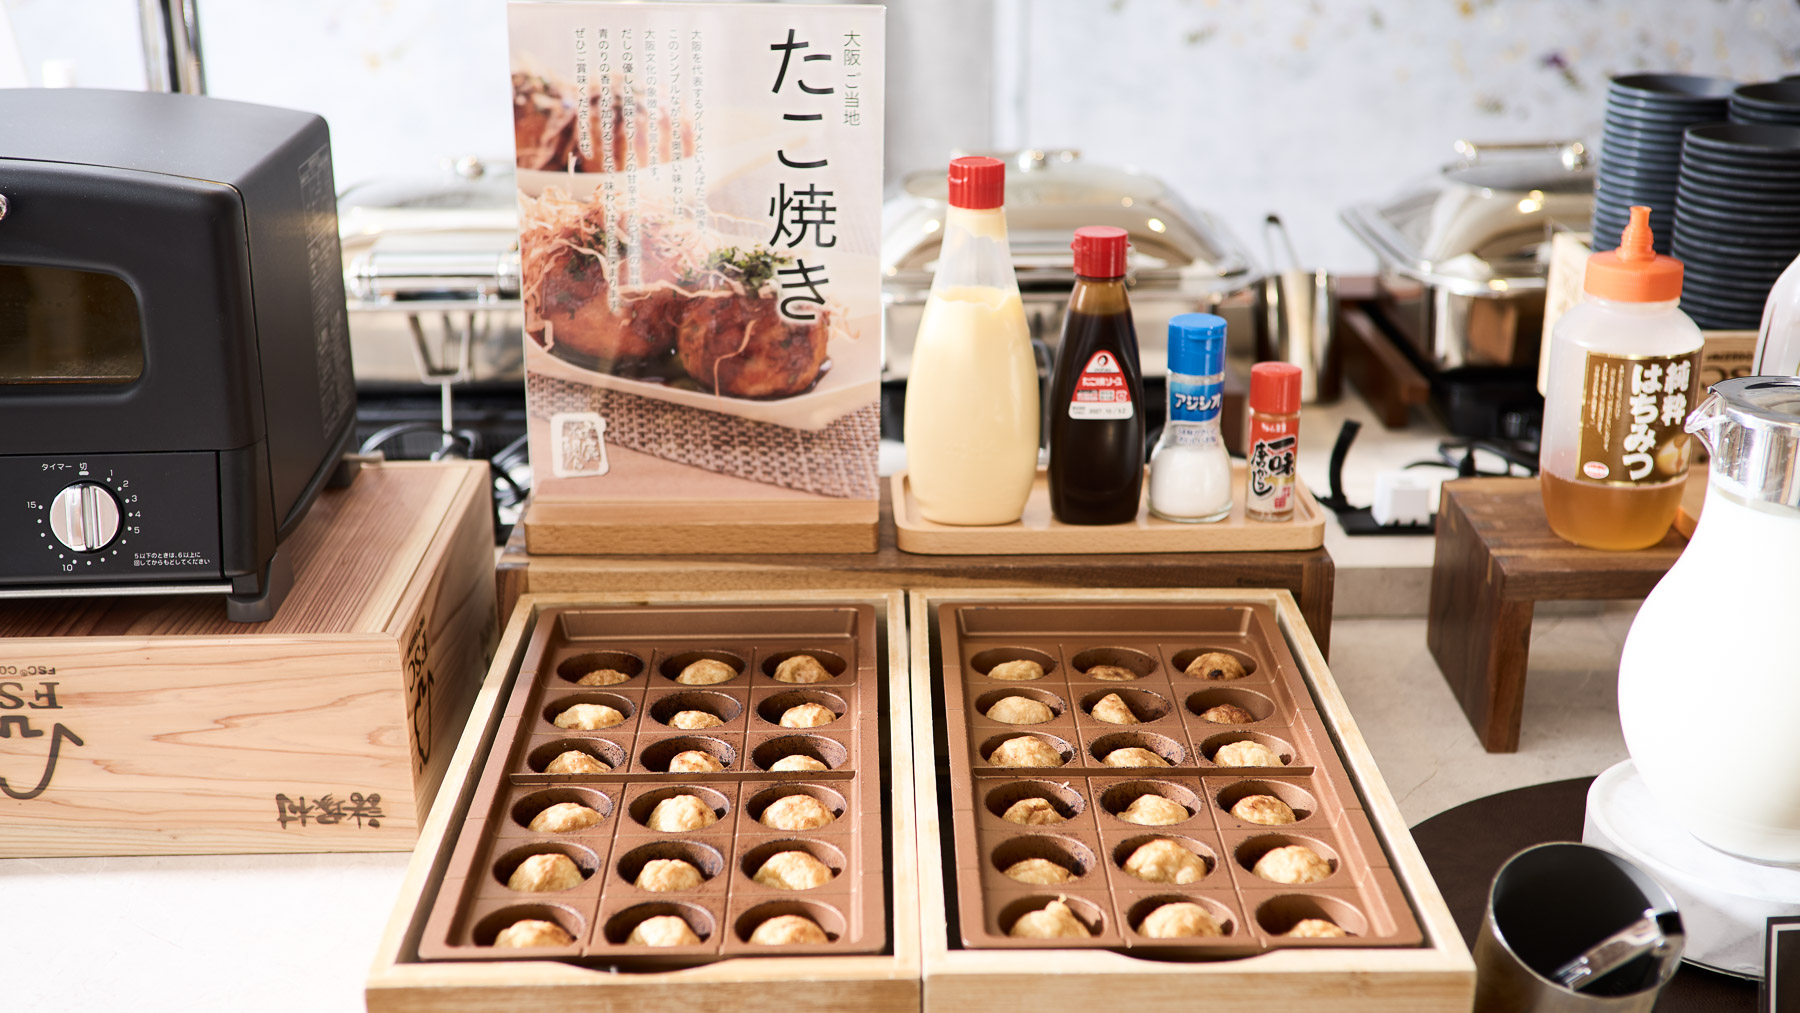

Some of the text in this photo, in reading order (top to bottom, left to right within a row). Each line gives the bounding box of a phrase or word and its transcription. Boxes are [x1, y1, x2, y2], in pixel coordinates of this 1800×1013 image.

[575, 27, 592, 158] ぜひご賞味くださいませ。
[769, 28, 837, 320] たこ焼き
[1661, 360, 1690, 426] 純粋
[1175, 392, 1221, 411] アジシオ
[1622, 363, 1663, 480] はちみつ
[1267, 437, 1295, 475] 一味
[41, 463, 72, 471] タイマー
[79, 462, 88, 471] 切
[109, 469, 114, 477] 1
[122, 480, 129, 488] 2
[131, 494, 138, 503] 3
[26, 501, 37, 509] 15
[134, 510, 141, 518] 4
[134, 526, 140, 534] 5
[62, 564, 73, 572] 10
